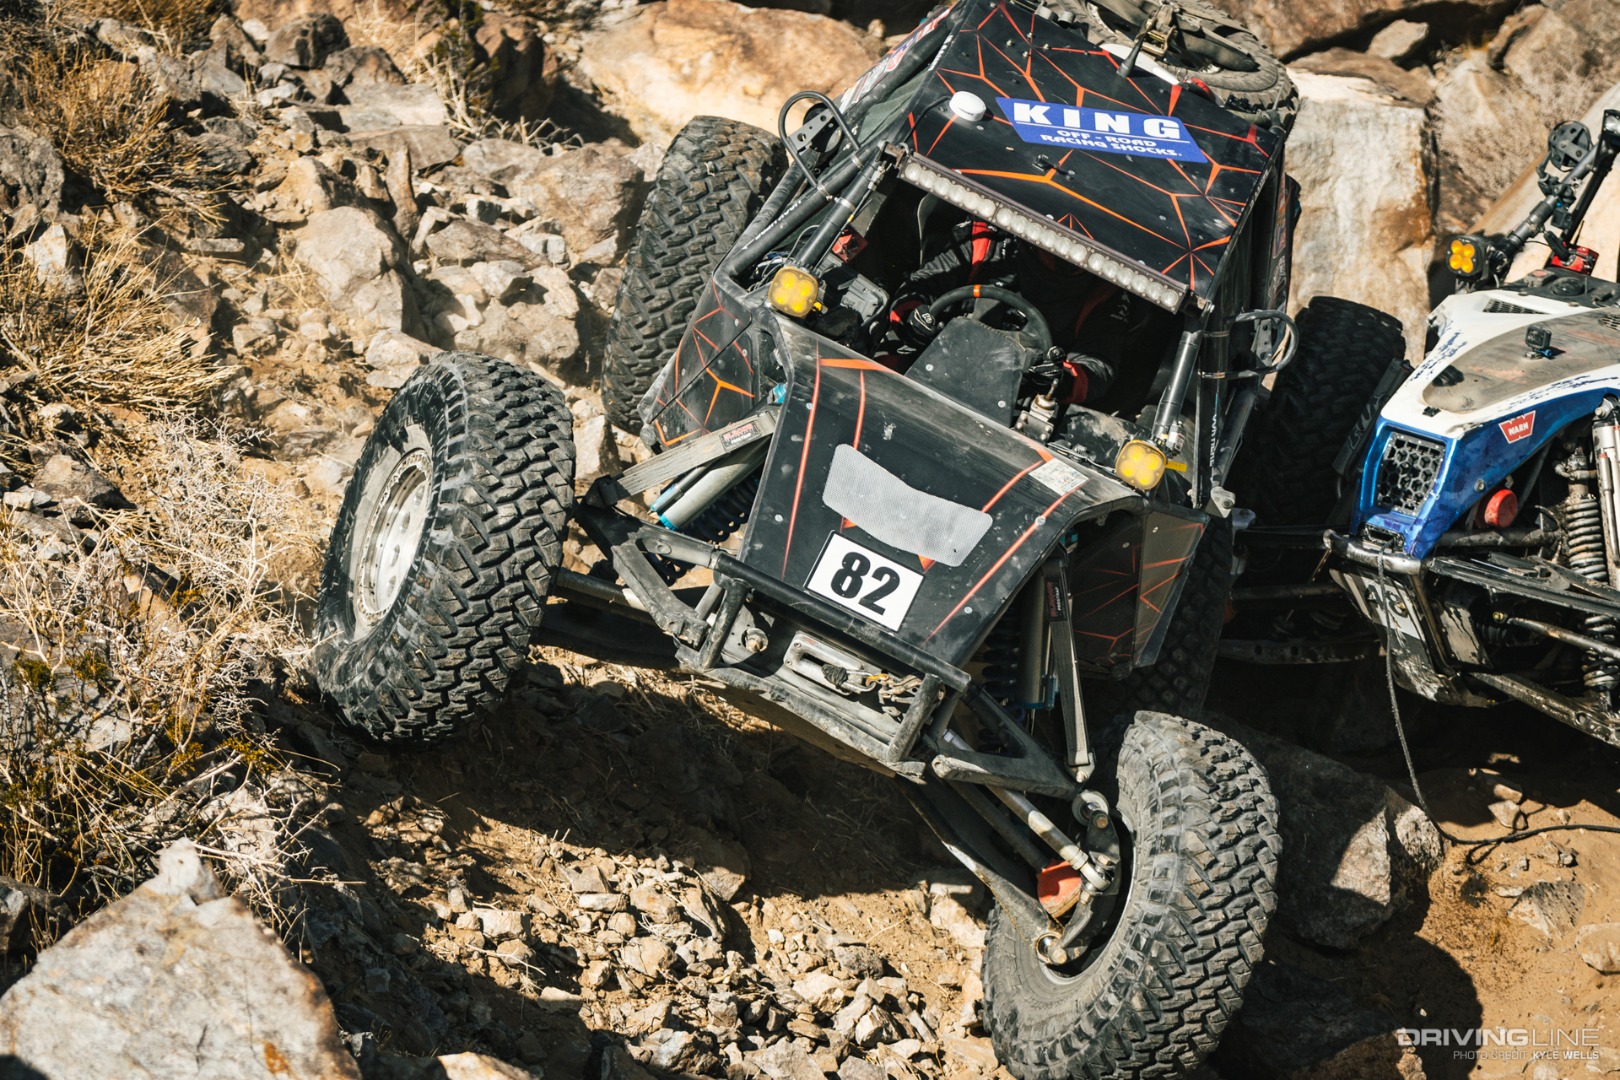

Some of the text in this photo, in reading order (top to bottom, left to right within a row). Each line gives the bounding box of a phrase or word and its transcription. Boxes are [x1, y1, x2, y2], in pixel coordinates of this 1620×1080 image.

[1013, 102, 1181, 139] KING
[1040, 134, 1109, 149] RACING
[1057, 130, 1090, 141] OFF
[1104, 136, 1157, 147] ROAD
[1508, 421, 1529, 436] WARN
[830, 551, 900, 617] 82
